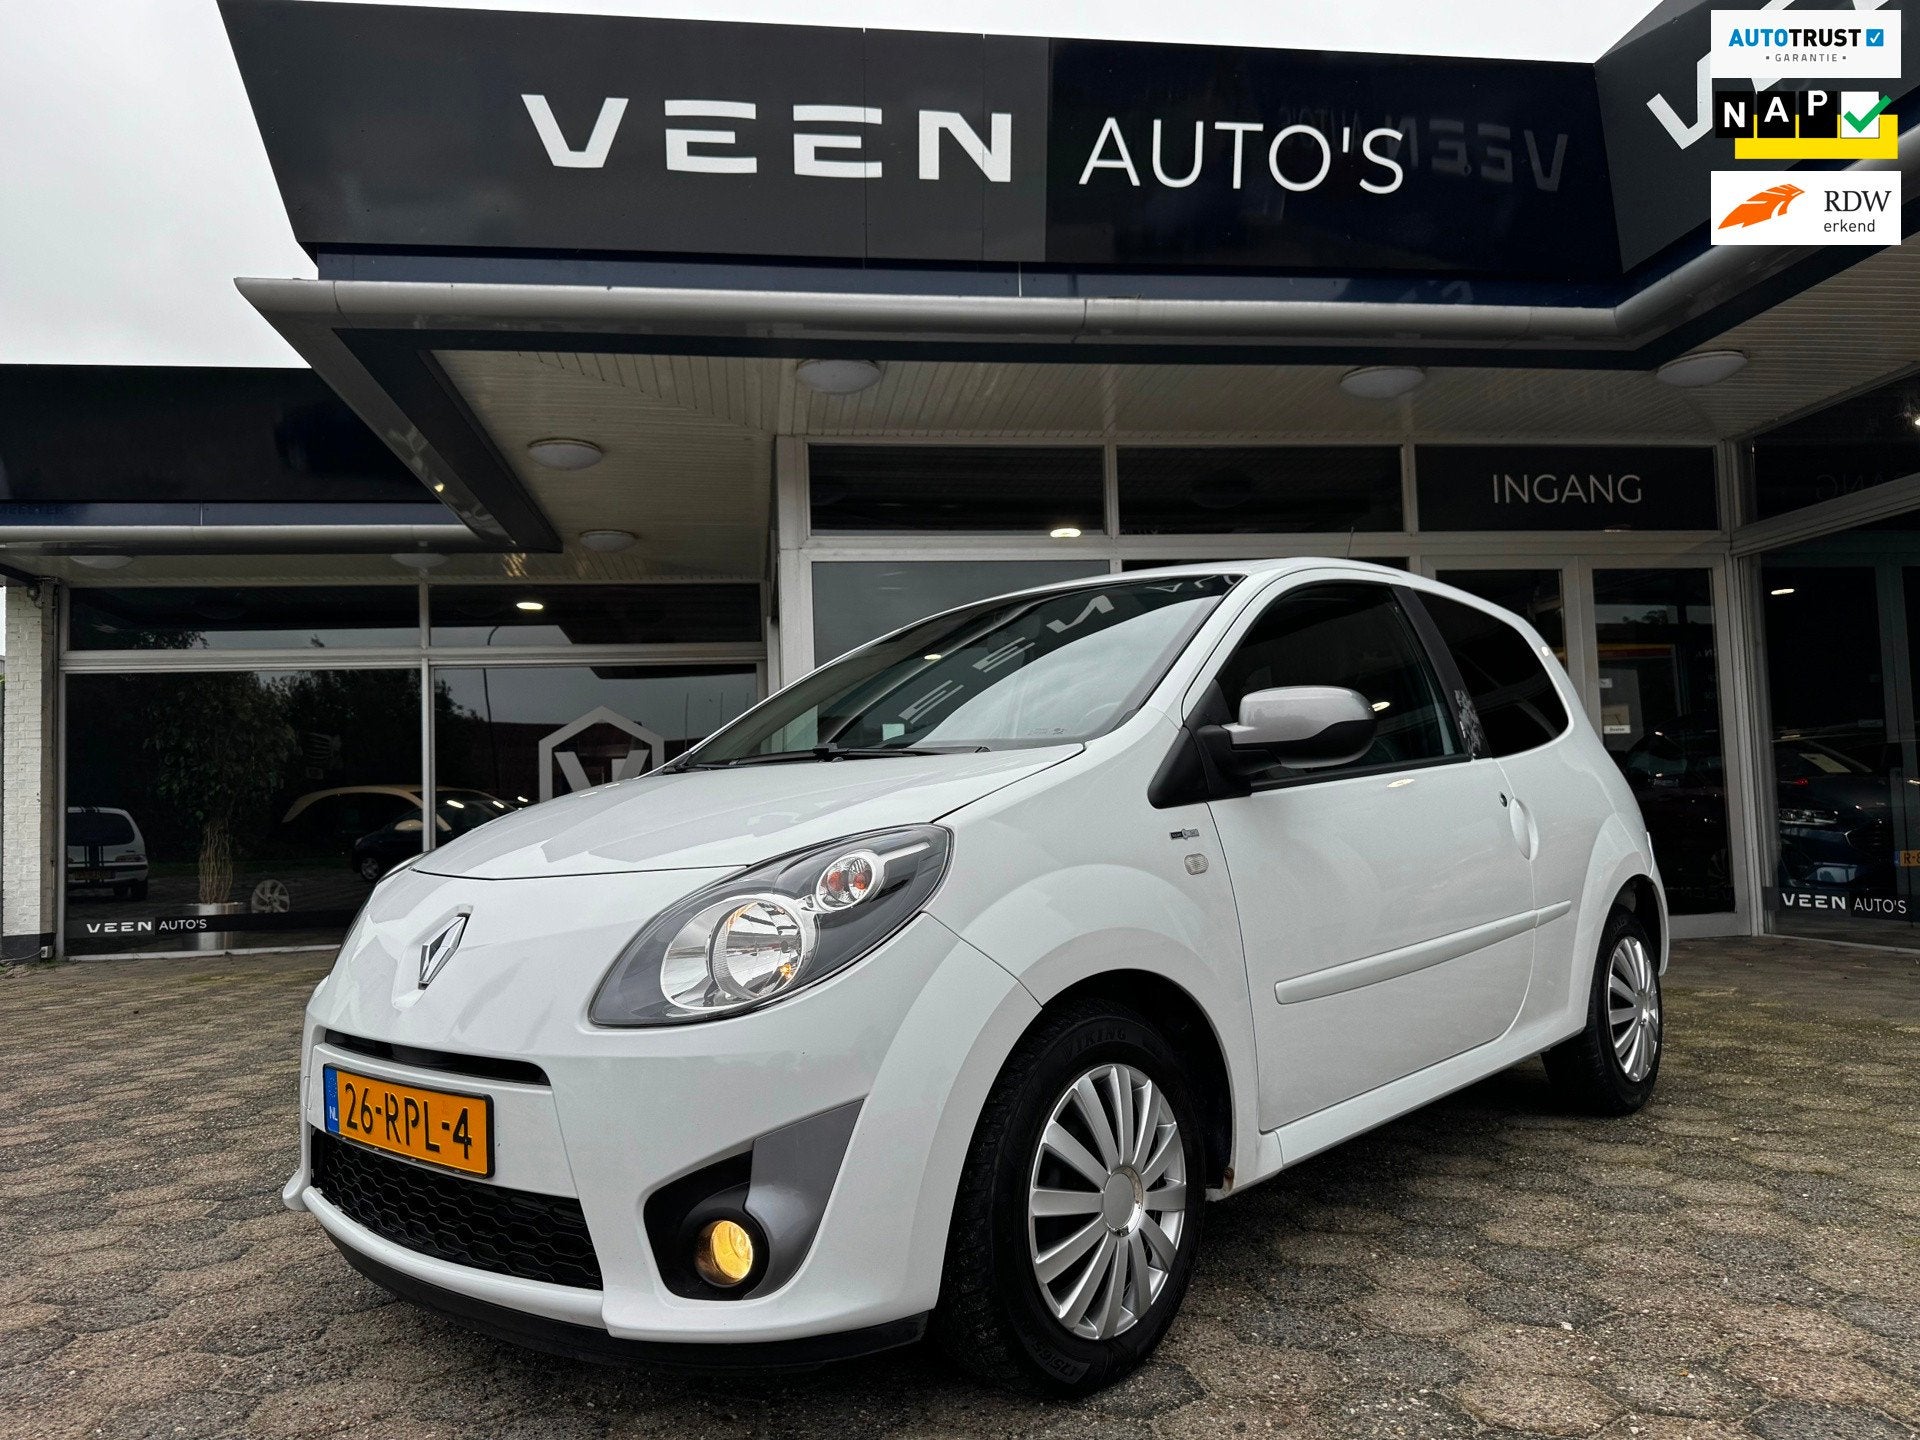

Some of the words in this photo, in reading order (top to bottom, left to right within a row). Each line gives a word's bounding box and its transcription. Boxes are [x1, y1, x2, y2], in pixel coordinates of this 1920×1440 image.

[521, 94, 1012, 182] VEEN
[1079, 117, 1404, 194] AUTO'S
[1493, 474, 1642, 504] INGANG
[1782, 893, 1846, 910] VEEN
[1854, 898, 1907, 914] AUTO'S
[86, 921, 152, 933] VEEN
[159, 919, 207, 930] AUTO'S
[344, 1083, 473, 1159] 26-RPL-4
